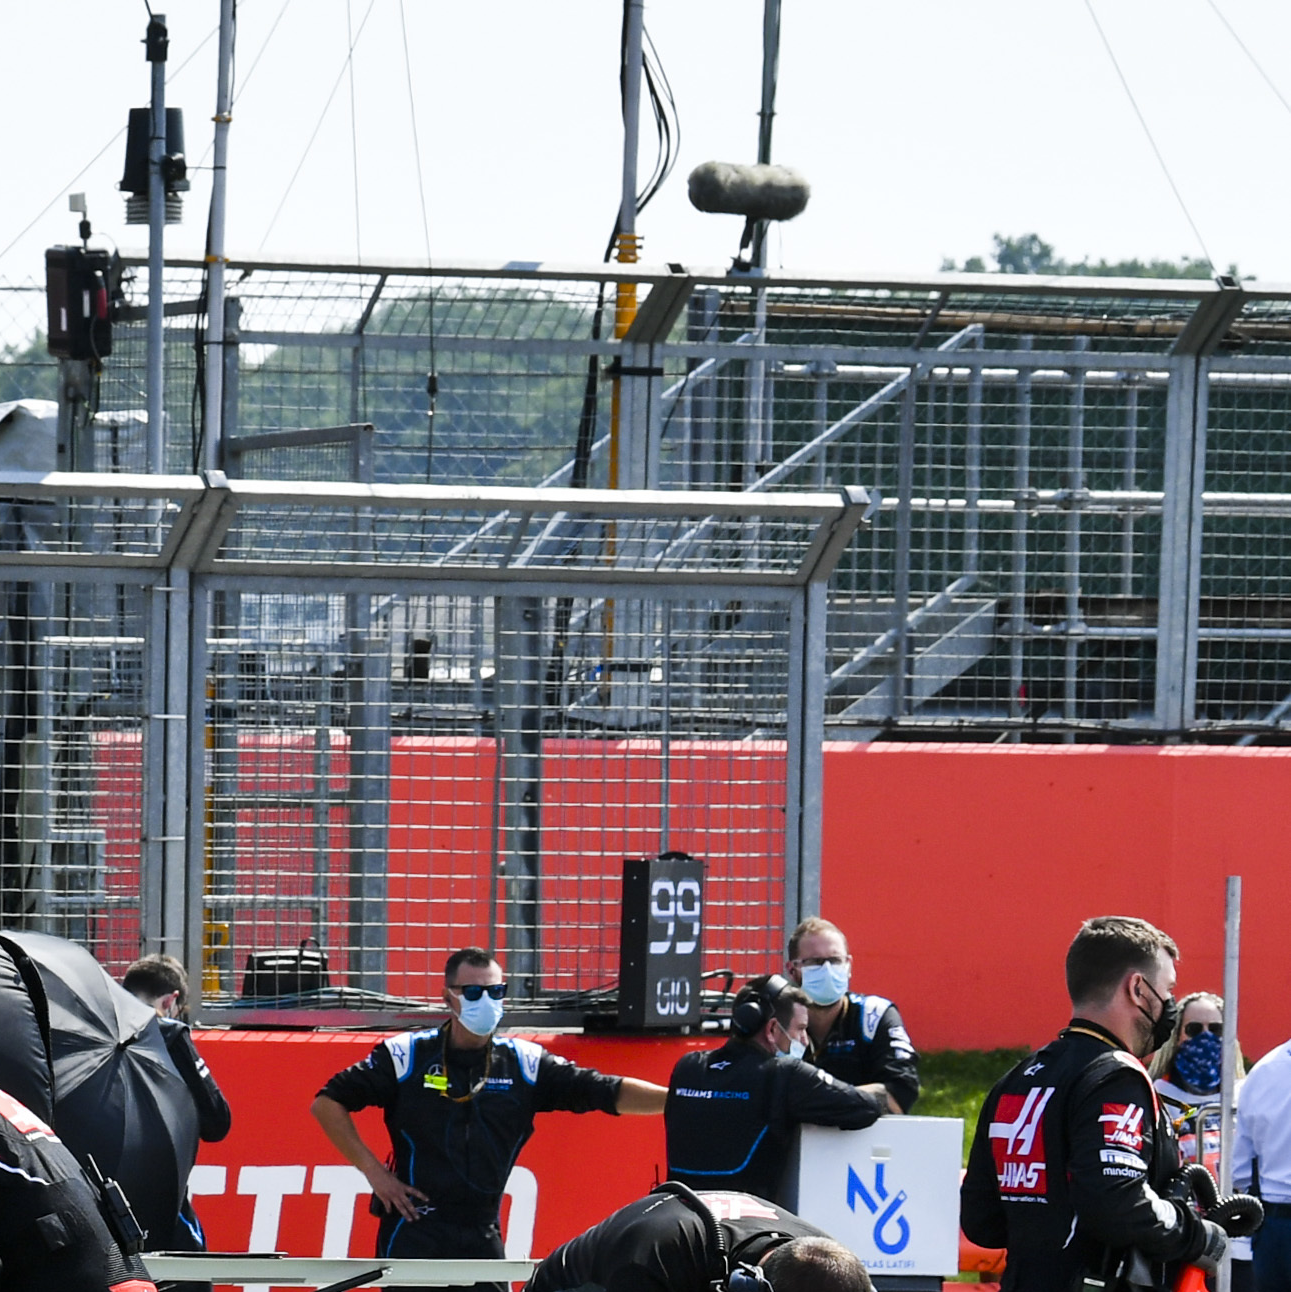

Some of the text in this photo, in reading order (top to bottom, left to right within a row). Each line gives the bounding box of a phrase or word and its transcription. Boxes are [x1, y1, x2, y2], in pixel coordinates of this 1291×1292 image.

[648, 876, 701, 954] 99
[675, 1087, 750, 1100] WILLIAMS RACING
[998, 1162, 1046, 1189] HAAS
